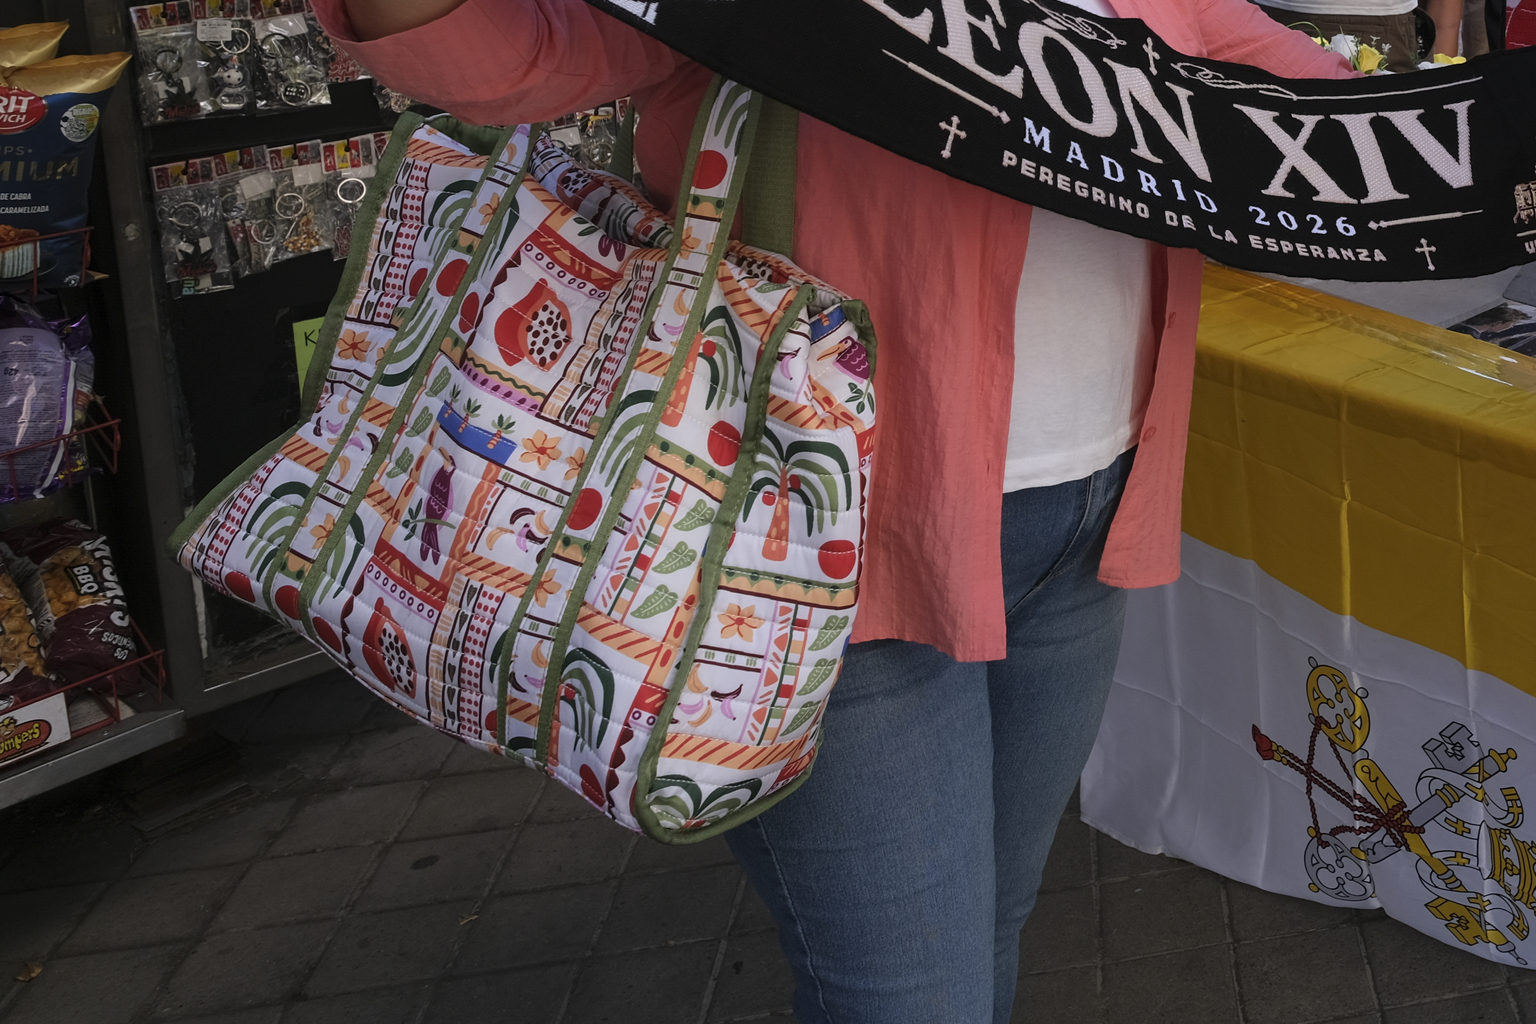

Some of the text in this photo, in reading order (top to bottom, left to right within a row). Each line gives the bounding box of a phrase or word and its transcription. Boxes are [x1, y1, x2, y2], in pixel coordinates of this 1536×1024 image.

[1233, 99, 1475, 205] XIV
[1024, 117, 1357, 237] MADRID 2026
[0, 205, 50, 215] CARAMELIZADA
[10, 192, 32, 201] CABRA
[1002, 149, 1388, 262] PEREGRINO DE LA ESPERANZA
[72, 564, 99, 595] BBQ
[113, 647, 129, 661] LOS
